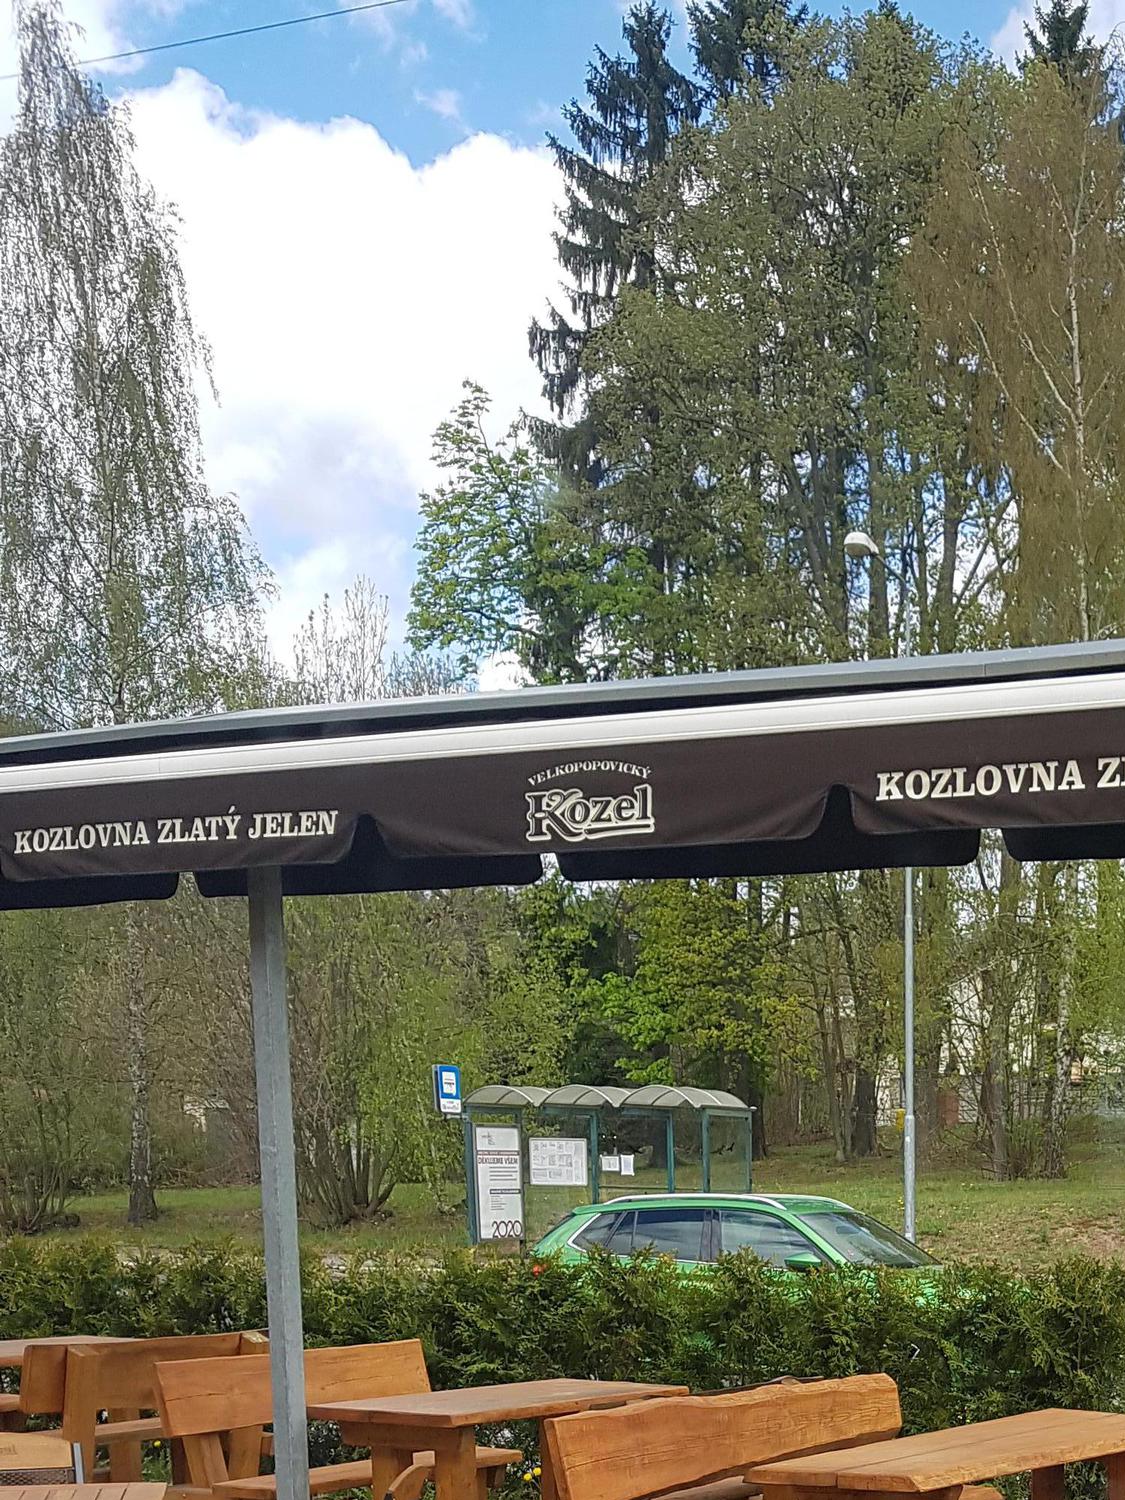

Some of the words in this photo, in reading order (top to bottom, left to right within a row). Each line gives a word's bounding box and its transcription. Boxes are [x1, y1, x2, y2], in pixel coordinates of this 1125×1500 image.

[528, 760, 651, 786] VELKOPOPOVICKÝ
[876, 759, 1085, 801] KOZLOVNA
[14, 820, 150, 854] KOZLOVNA
[157, 806, 241, 844] ZLATÝ
[248, 810, 339, 839] JELEN
[525, 784, 656, 842] Kozel
[492, 1220, 522, 1238] 2020
